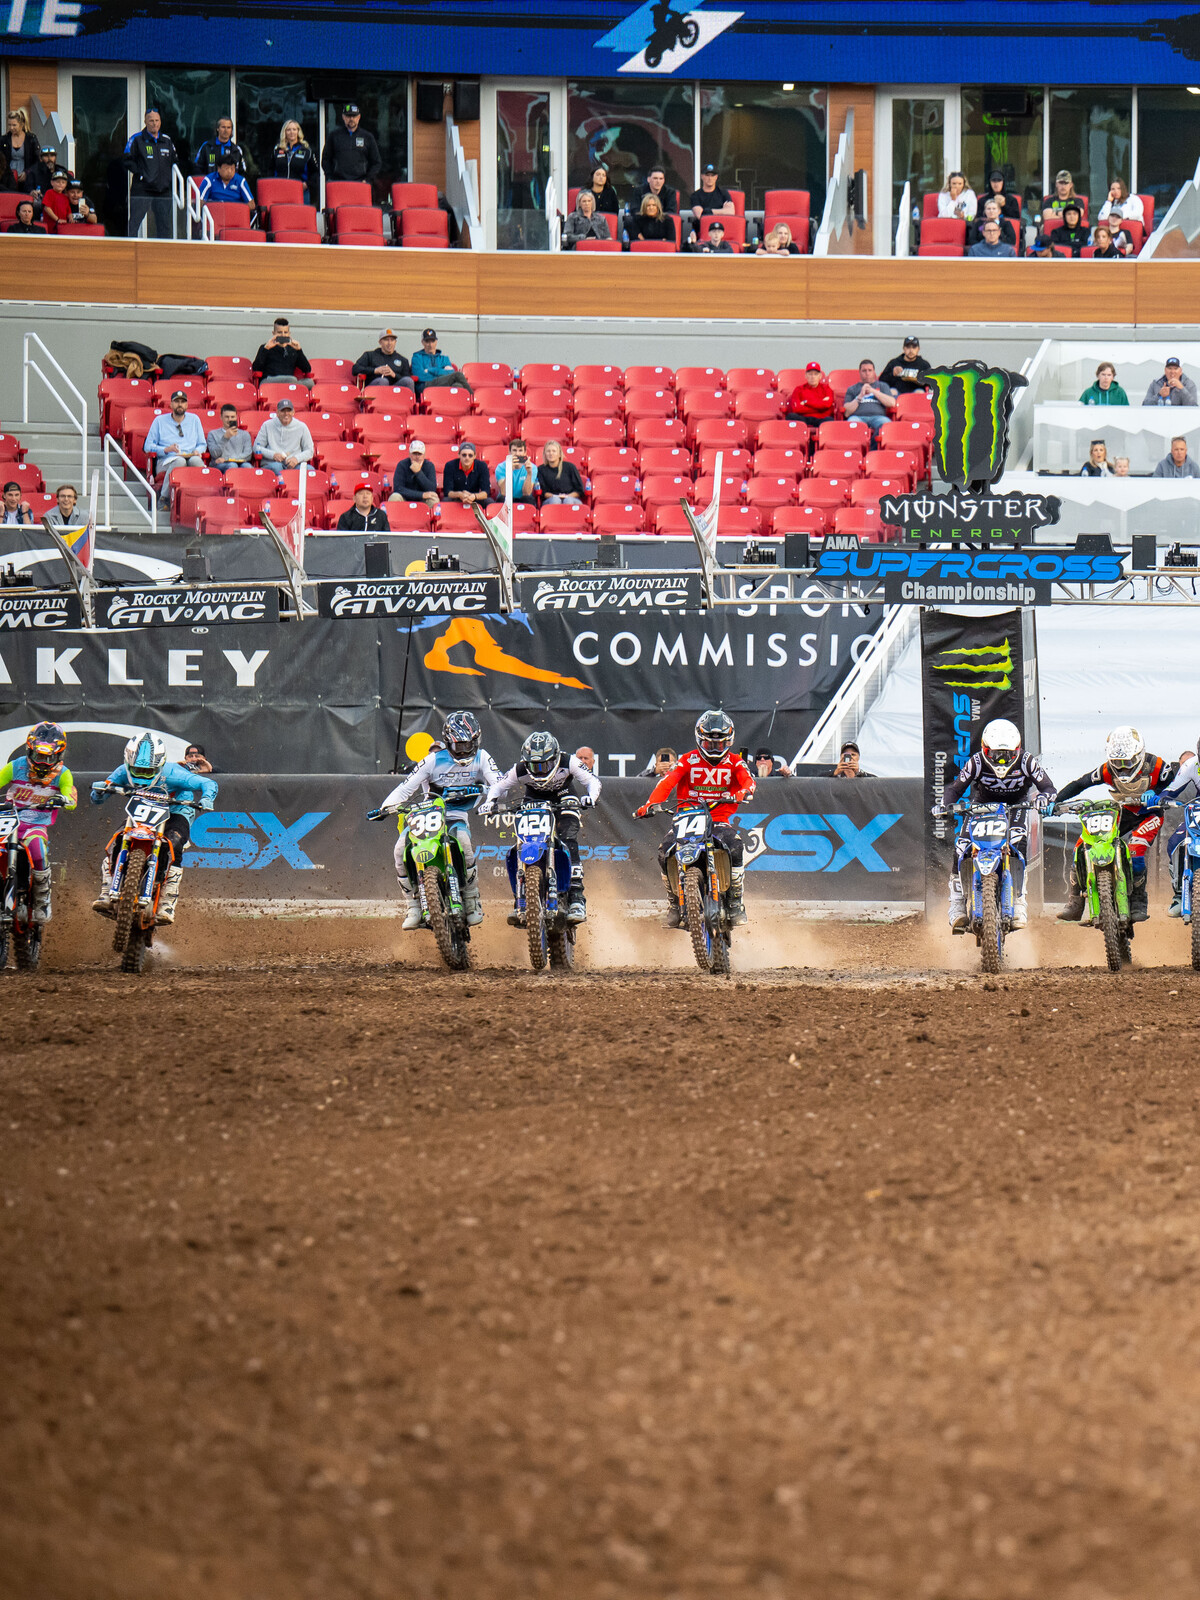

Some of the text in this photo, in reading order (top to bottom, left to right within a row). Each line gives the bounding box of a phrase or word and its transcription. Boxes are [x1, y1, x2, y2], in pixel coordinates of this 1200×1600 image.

[884, 495, 1047, 523] MONSTER
[911, 529, 1023, 538] ENERGY
[826, 537, 859, 550] AMA
[816, 552, 1131, 580] SUPERCROSS
[356, 582, 487, 596] ROCKY MOUNTAIN
[557, 577, 689, 591] ROCKY MOUNTAIN
[901, 582, 1036, 602] Championship
[131, 591, 266, 606] ROCKY MOUNTAIN
[971, 699, 981, 722] AMA
[691, 767, 732, 785] FXR
[133, 804, 166, 825] 97
[411, 811, 442, 837] 38
[1086, 815, 1113, 833] 198
[518, 814, 551, 836] 424
[675, 815, 706, 839] 14
[972, 820, 1007, 837] 412
[1137, 816, 1161, 835] MSR
